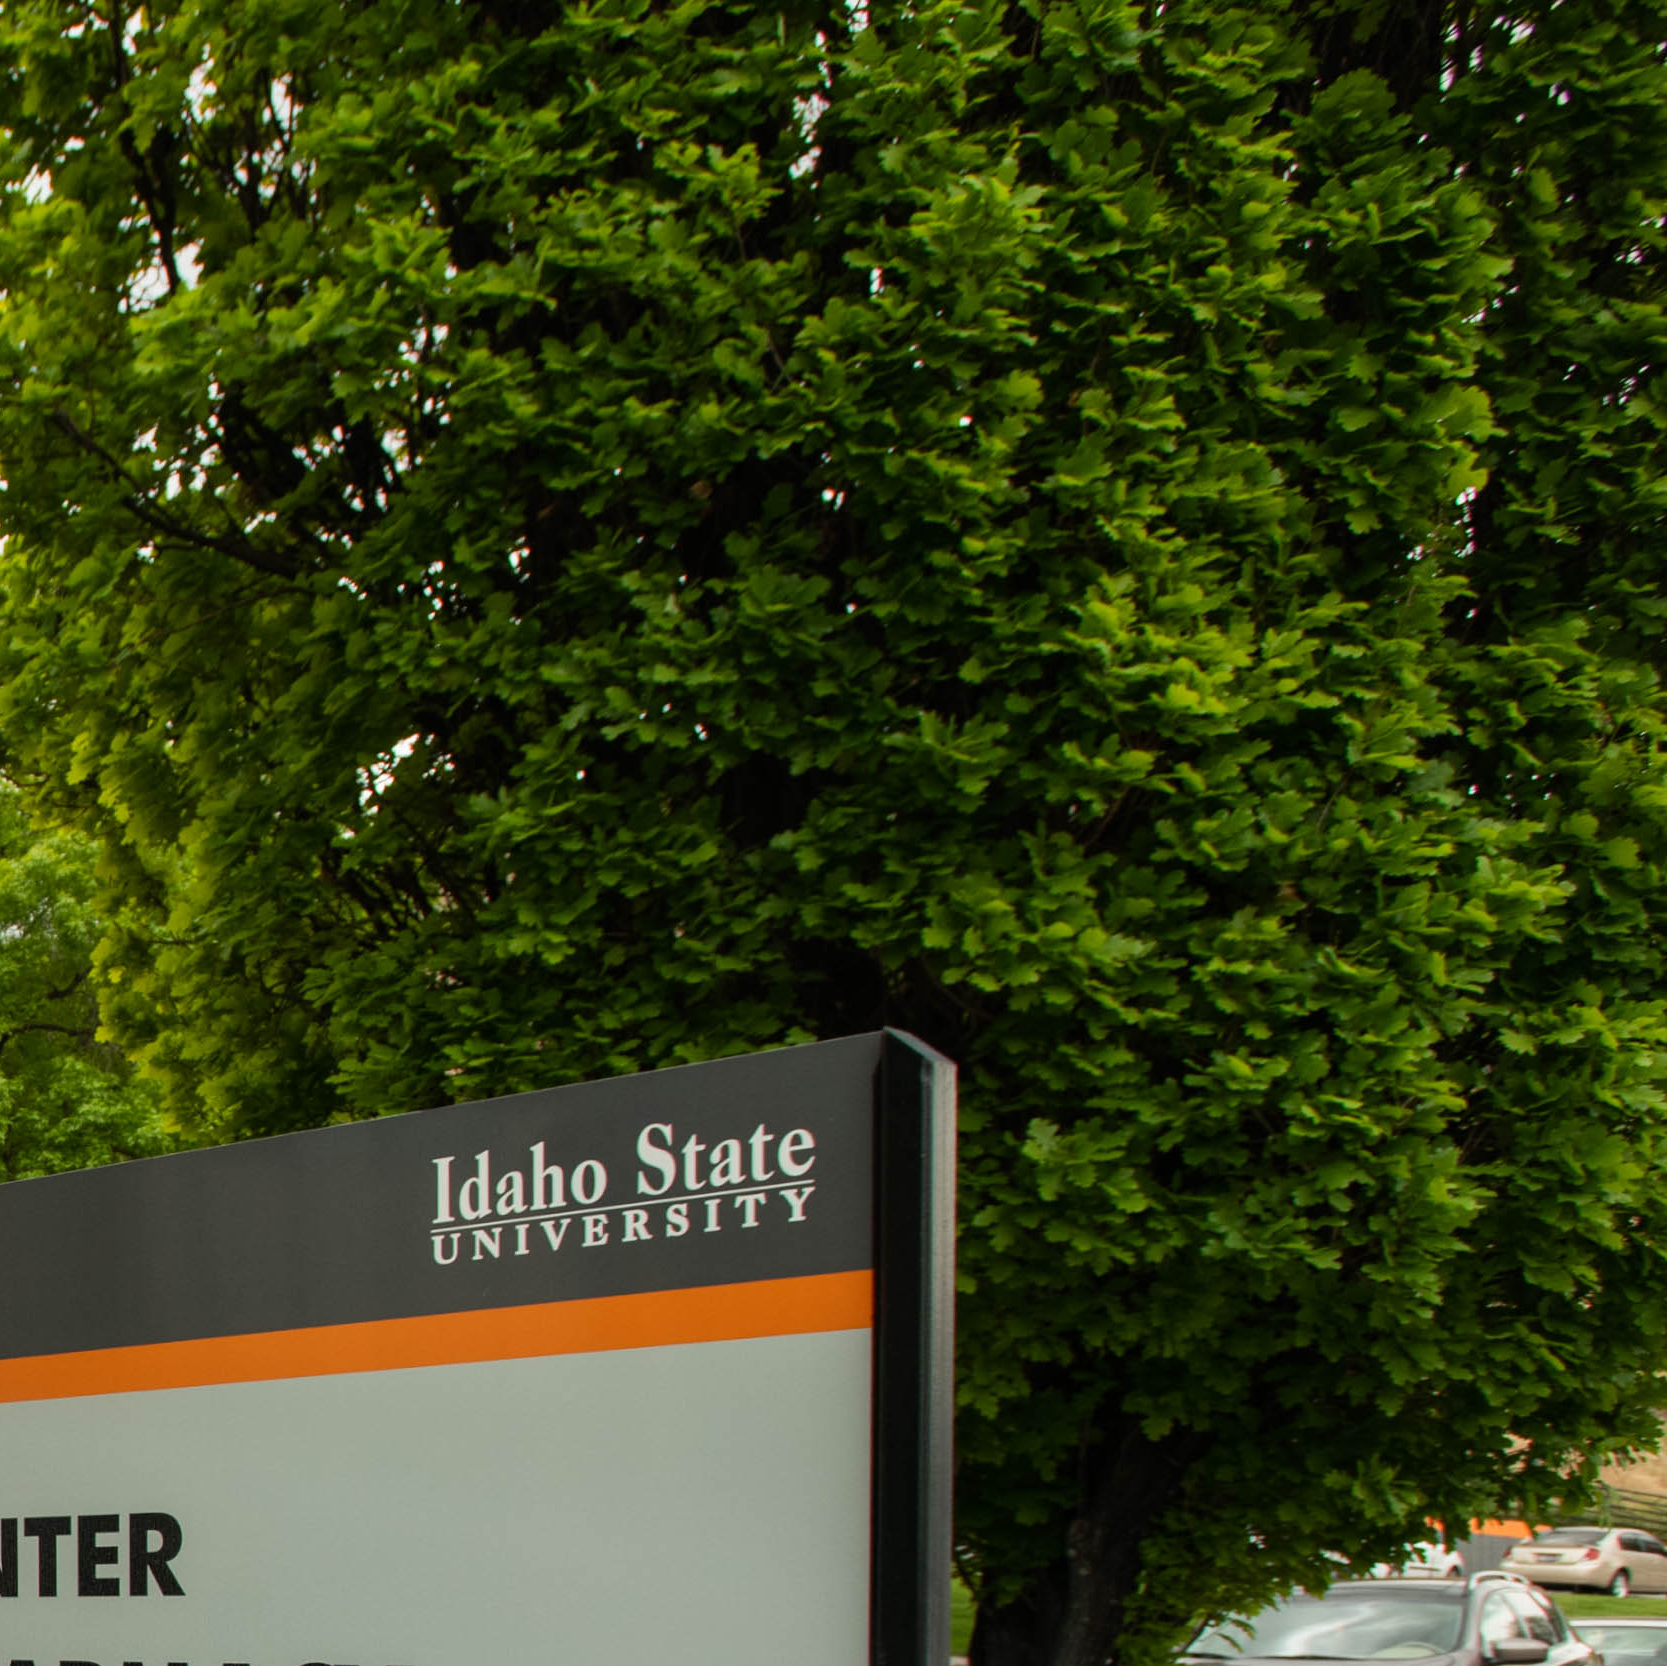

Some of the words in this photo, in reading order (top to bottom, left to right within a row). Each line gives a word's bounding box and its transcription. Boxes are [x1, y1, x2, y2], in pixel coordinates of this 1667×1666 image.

[432, 1141, 608, 1225] Idaho
[636, 1123, 816, 1196] State
[431, 1187, 816, 1265] UNIVERSITY
